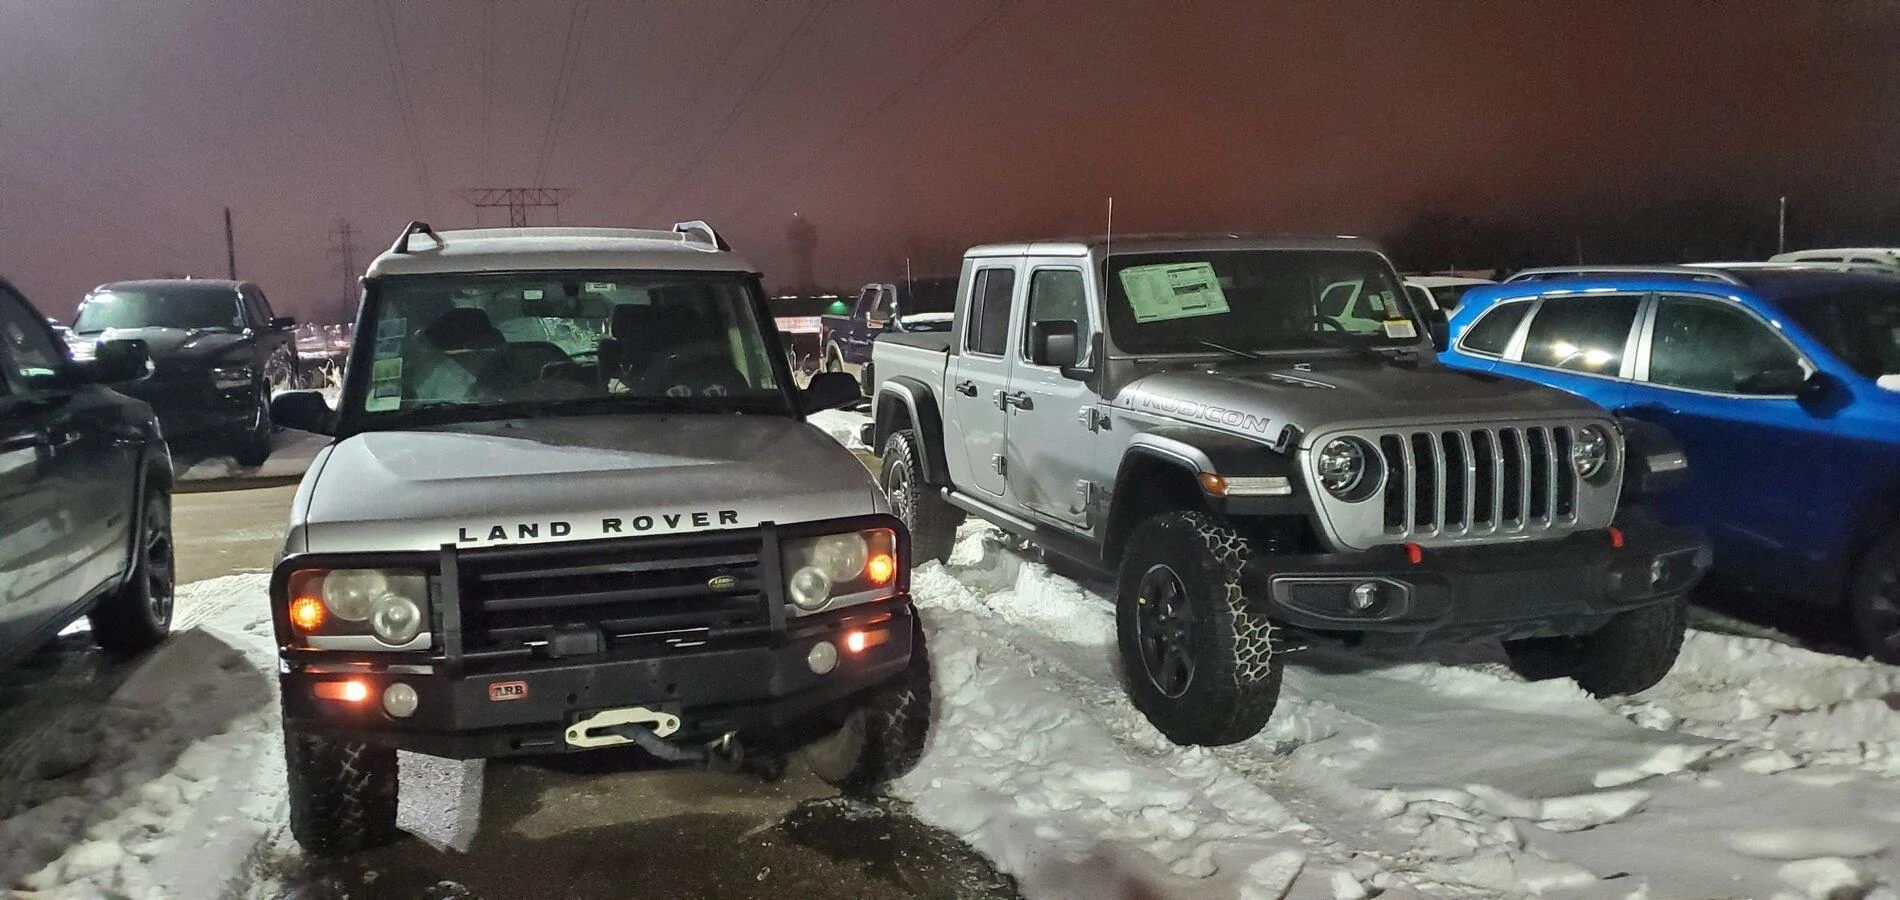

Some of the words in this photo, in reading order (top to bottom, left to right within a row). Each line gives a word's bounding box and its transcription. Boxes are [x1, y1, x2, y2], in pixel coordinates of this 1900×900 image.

[1143, 396, 1271, 433] RUBICON
[459, 521, 571, 543] LAND
[602, 510, 739, 534] ROVER
[495, 685, 523, 697] ARB
